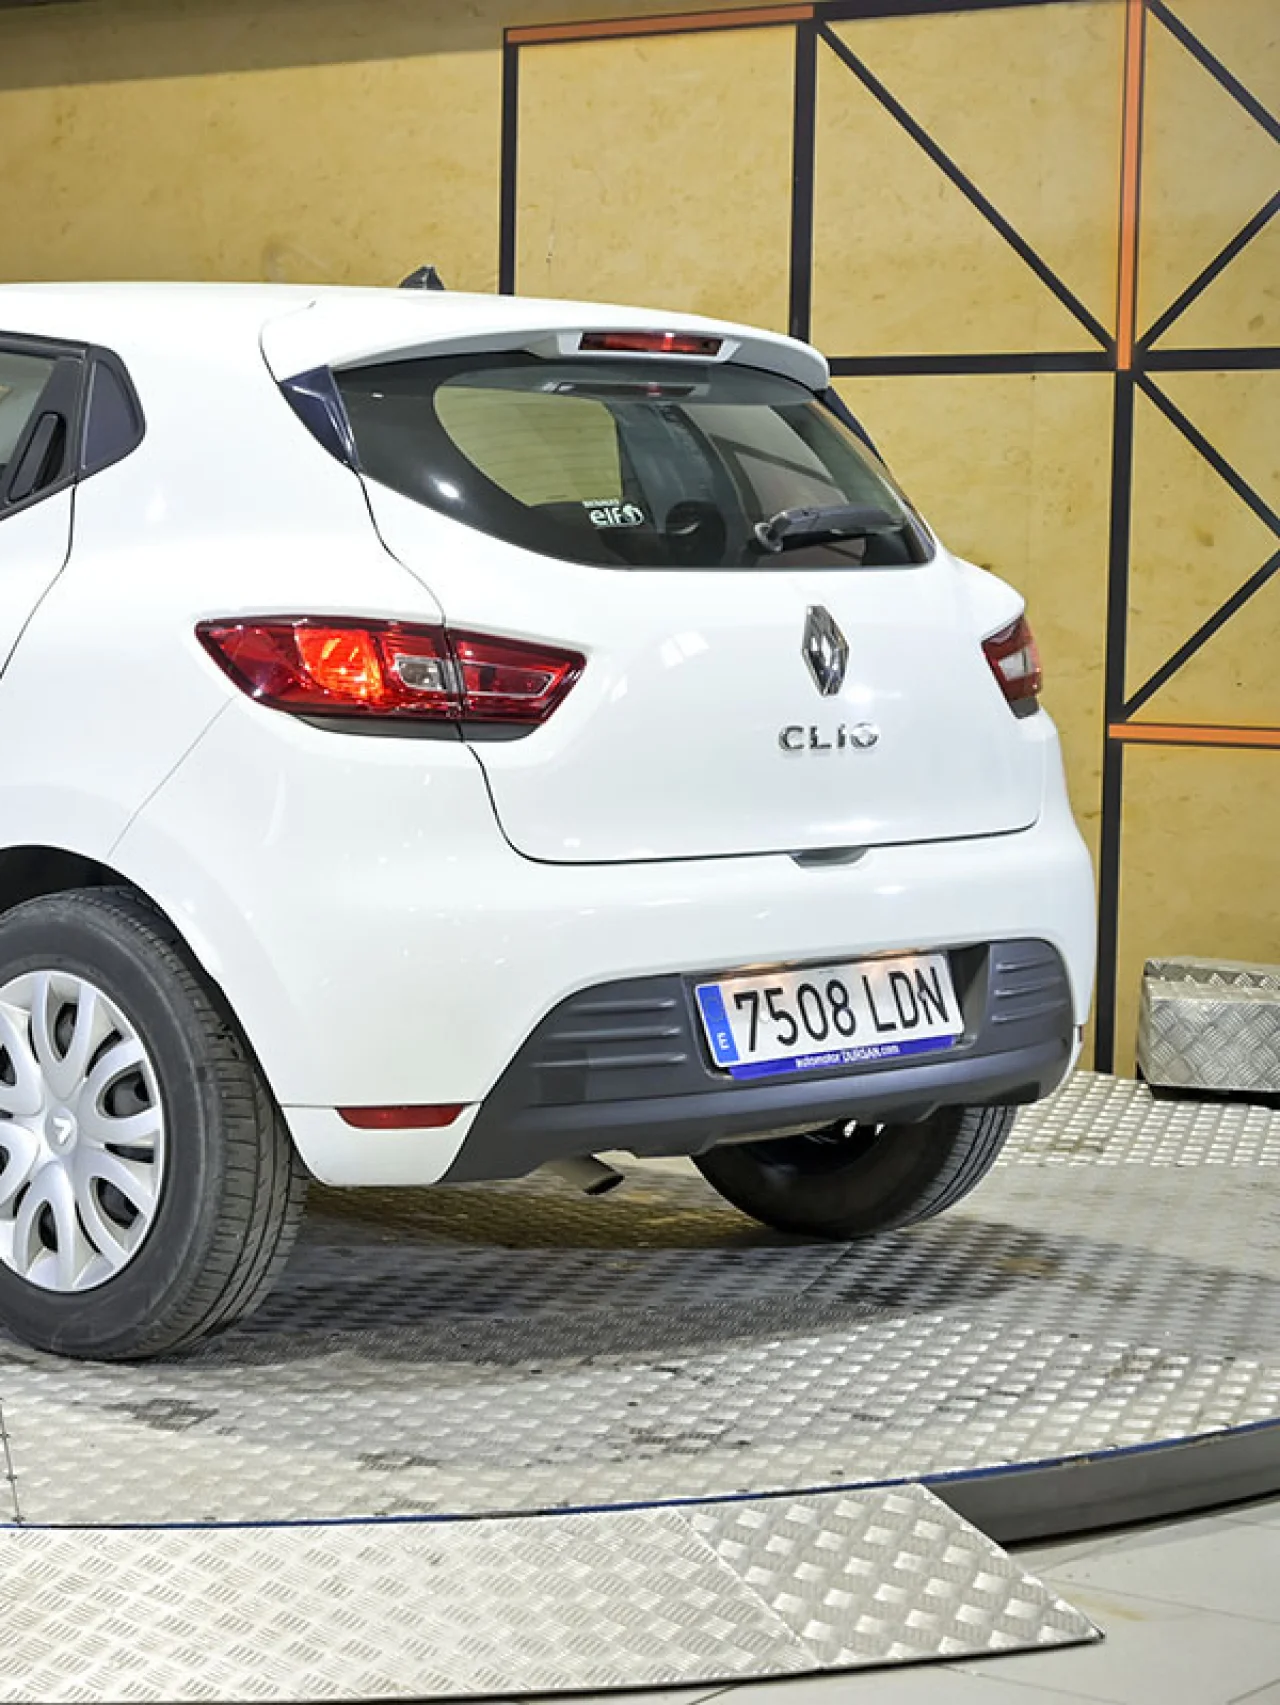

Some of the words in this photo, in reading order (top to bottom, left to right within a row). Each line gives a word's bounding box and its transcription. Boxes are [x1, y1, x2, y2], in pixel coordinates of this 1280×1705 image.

[734, 979, 857, 1052] 7508
[862, 967, 950, 1032] LDN
[716, 1032, 729, 1050] E
